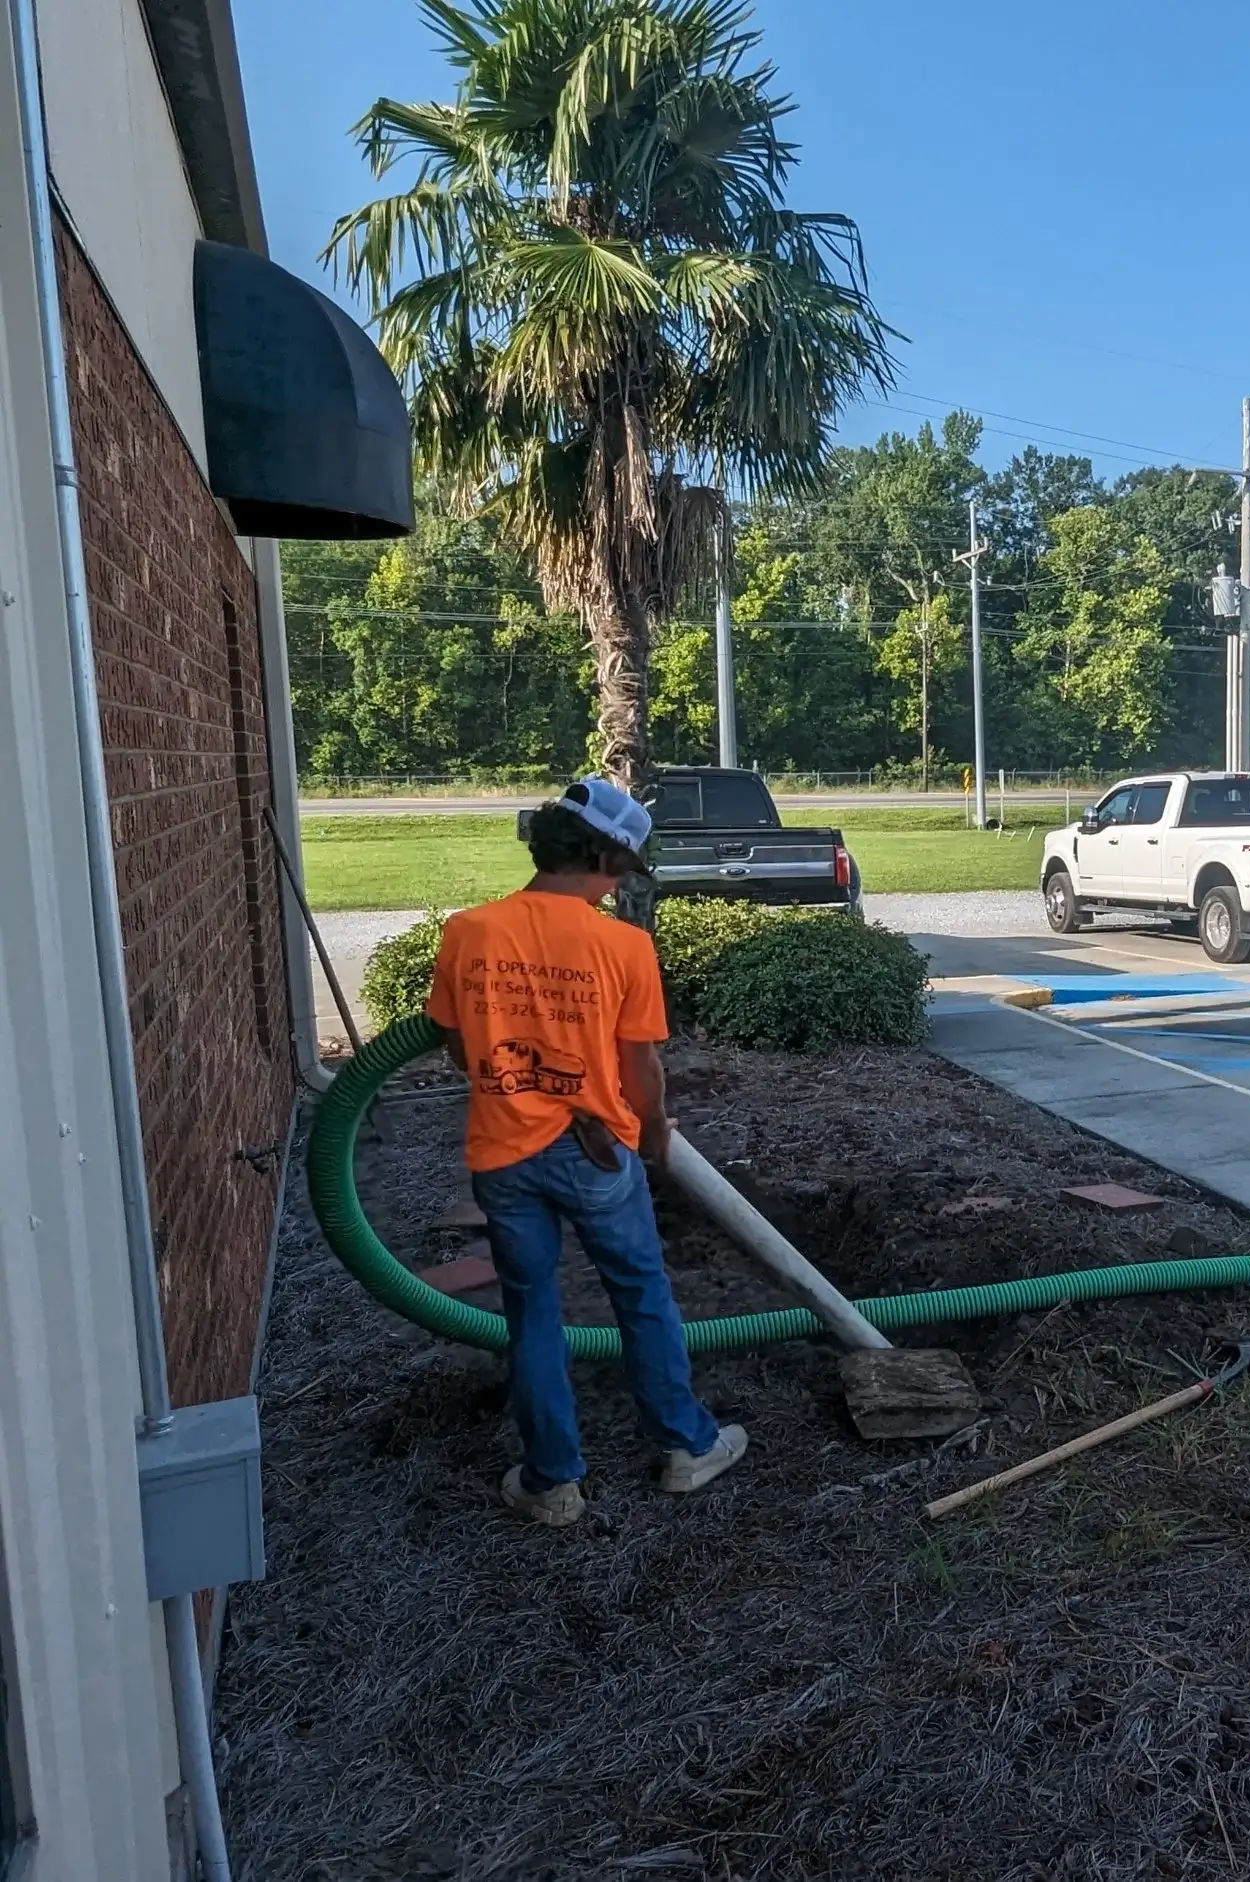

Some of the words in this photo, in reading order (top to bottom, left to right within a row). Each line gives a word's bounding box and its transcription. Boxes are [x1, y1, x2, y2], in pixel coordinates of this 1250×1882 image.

[469, 958, 490, 973] JPL
[497, 959, 595, 985] OPERATIONS
[463, 978, 485, 995] Dig
[490, 980, 500, 992] It
[506, 981, 565, 1001] Services
[571, 990, 600, 1005] LLC
